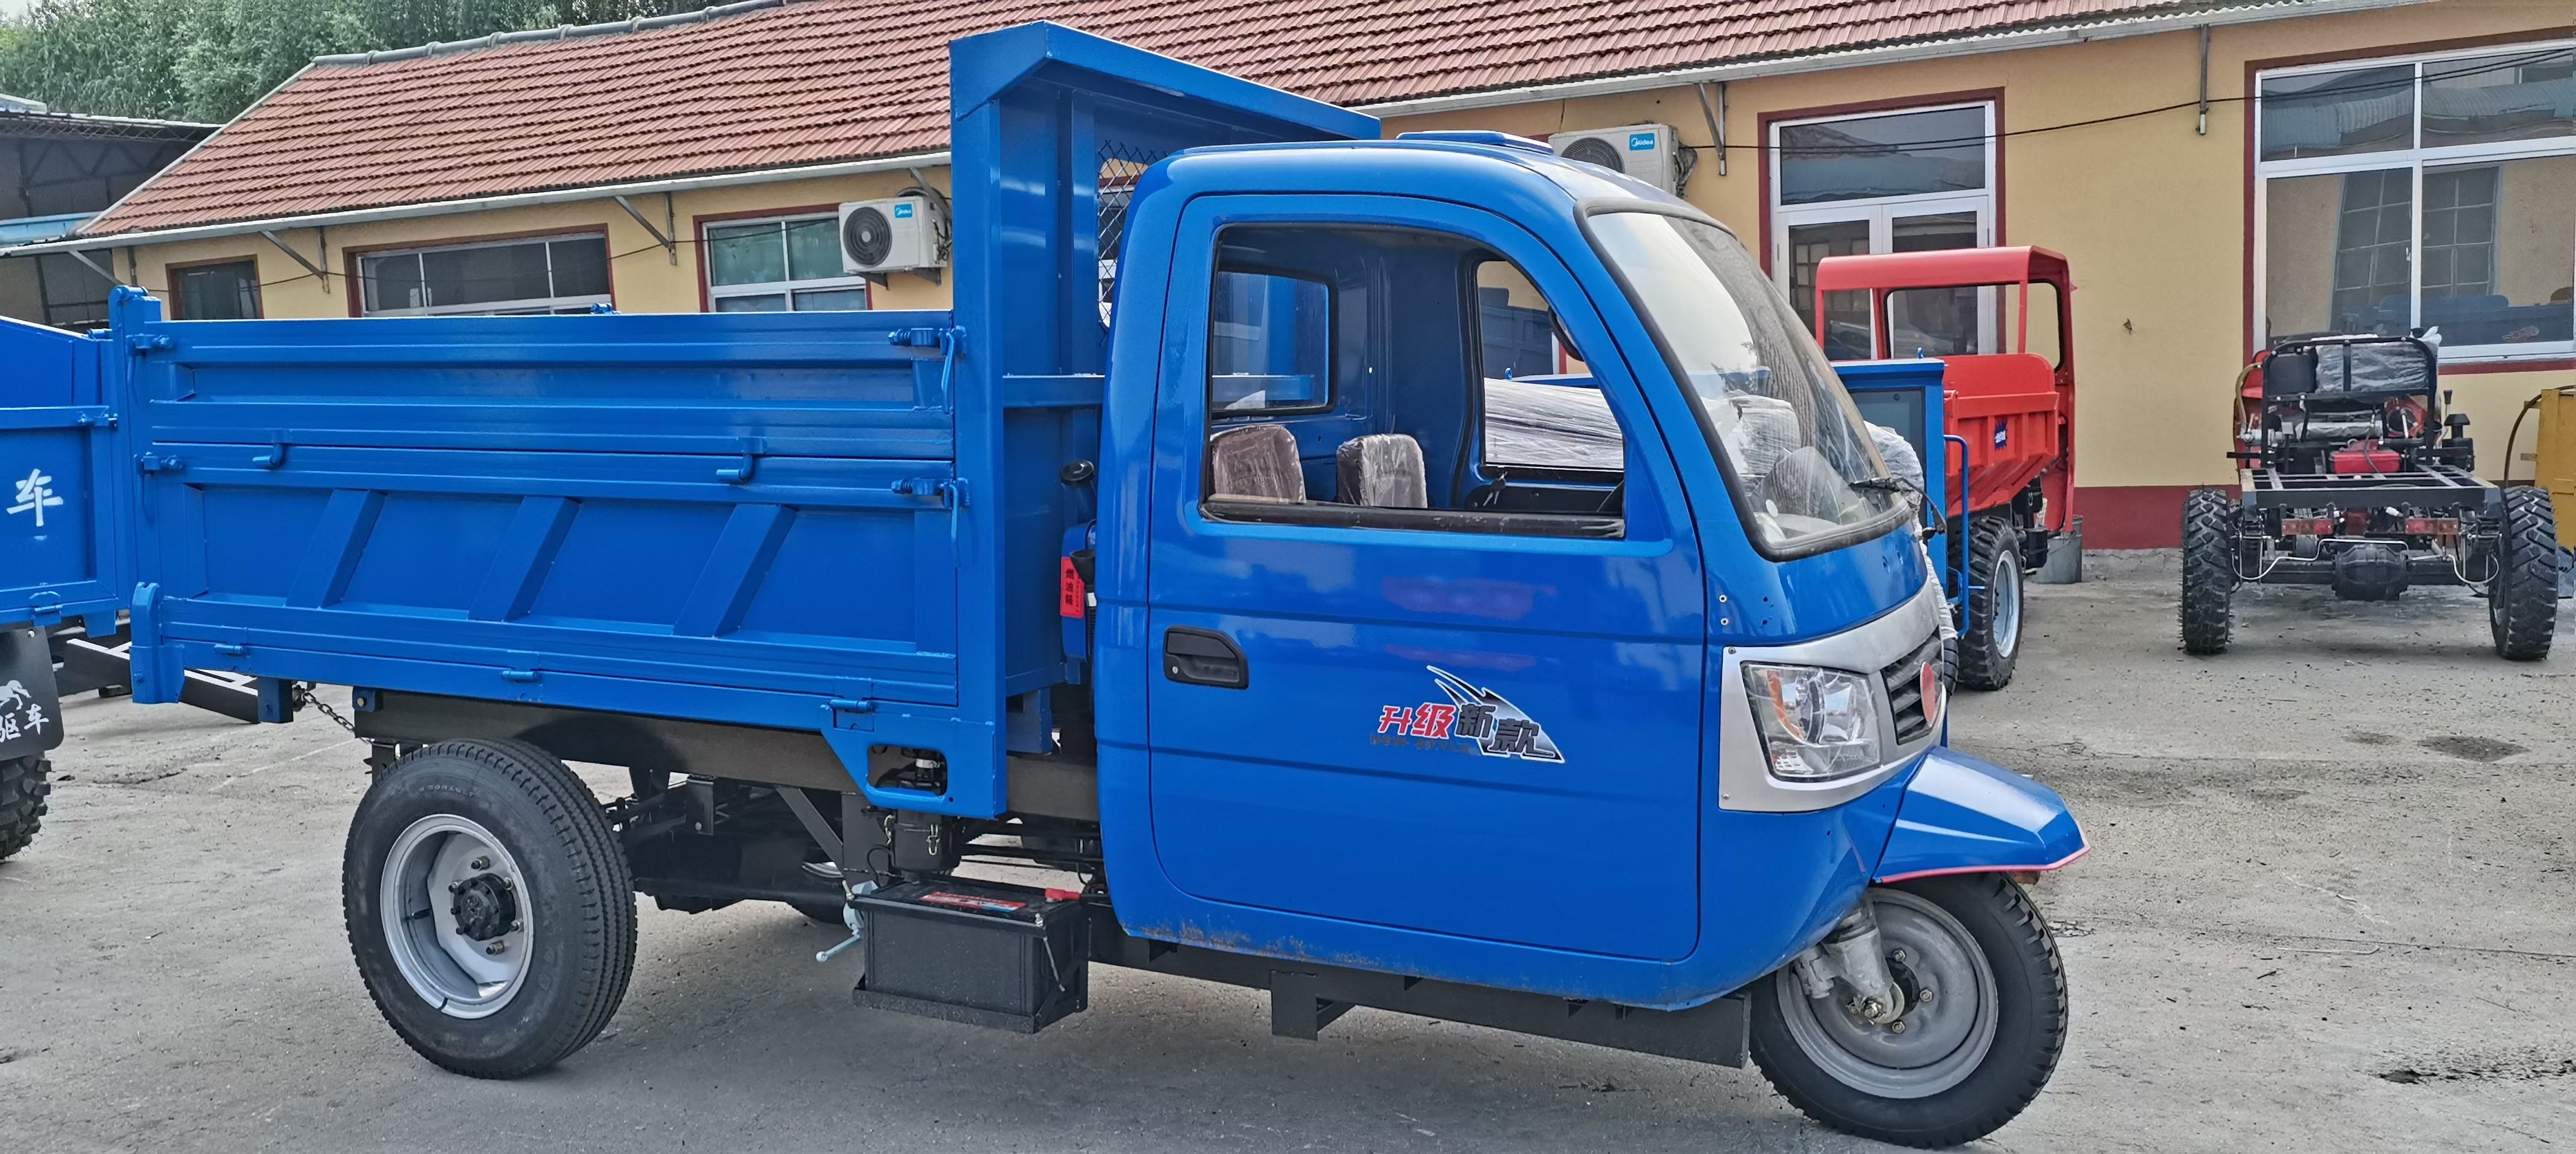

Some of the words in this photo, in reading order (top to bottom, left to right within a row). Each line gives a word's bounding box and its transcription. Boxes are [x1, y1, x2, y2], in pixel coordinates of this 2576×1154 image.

[1631, 138, 1654, 147] Midea
[6, 468, 64, 527] 车
[1378, 702, 1556, 757] 升级新款
